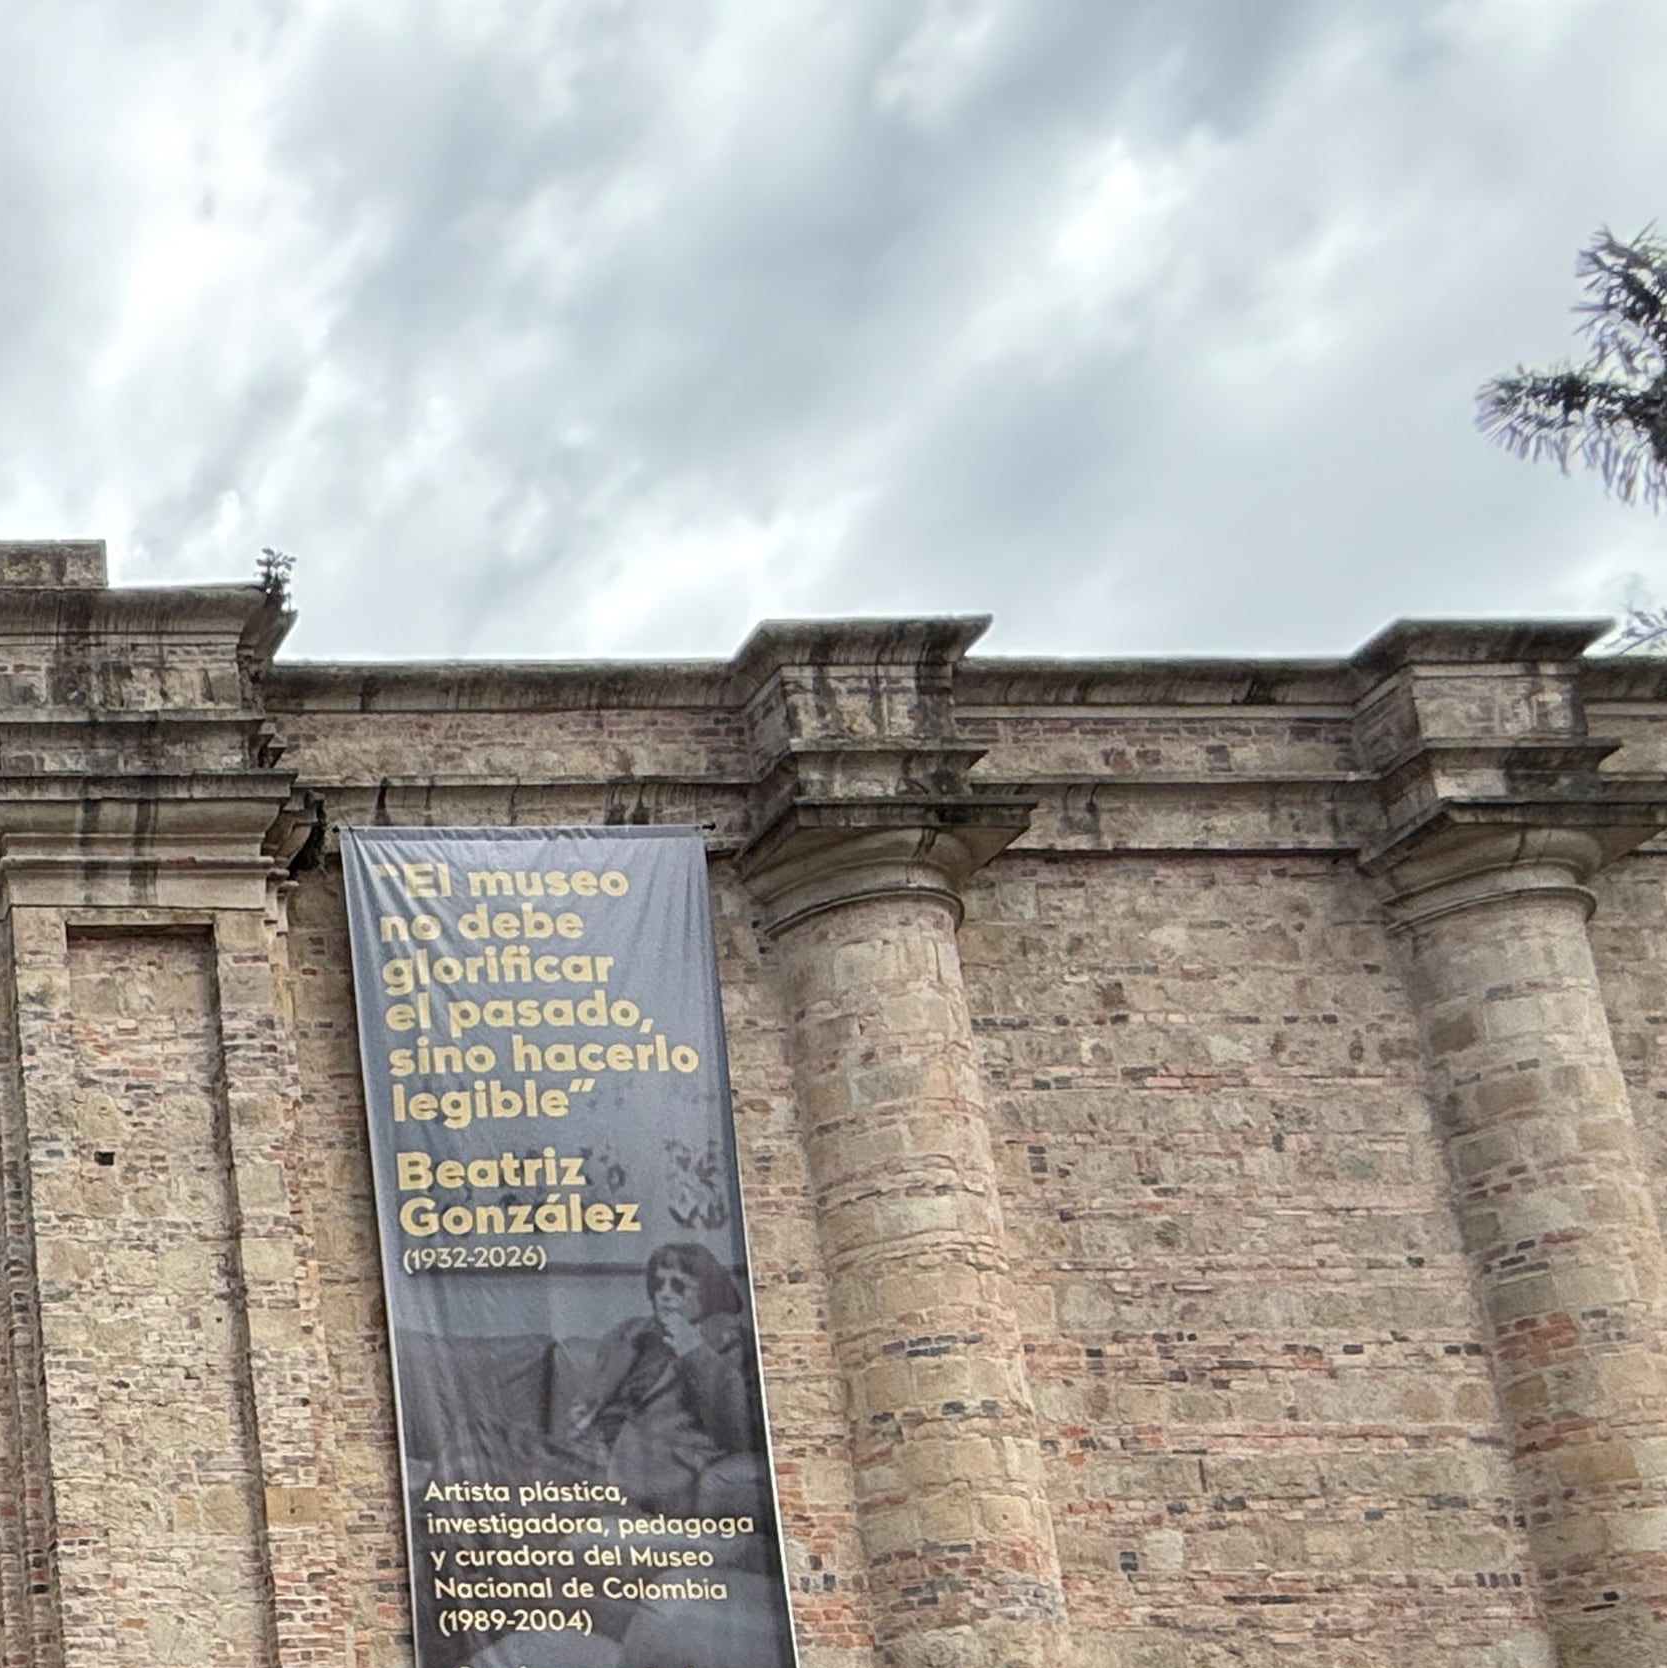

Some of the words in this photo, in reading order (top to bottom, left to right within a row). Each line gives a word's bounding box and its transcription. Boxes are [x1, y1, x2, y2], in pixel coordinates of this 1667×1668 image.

[467, 868, 630, 897] museo
[380, 913, 442, 942] no
[457, 903, 584, 940] debe
[382, 945, 614, 996] glorificar
[385, 993, 432, 1031] el
[449, 990, 653, 1038] pasado,
[389, 1038, 496, 1077] sino
[512, 1034, 699, 1073] hacerlo
[396, 1147, 587, 1192] Beatriz
[399, 1192, 642, 1237] González
[403, 1245, 547, 1275] (1932-2026)
[425, 1480, 510, 1502] Artista
[519, 1480, 628, 1507] plástica,
[427, 1513, 610, 1539] investigadora,
[619, 1514, 754, 1540] pedagoga
[430, 1550, 446, 1571] y
[455, 1544, 574, 1567] curadora
[584, 1544, 622, 1566] del
[630, 1547, 714, 1567] Museo
[434, 1577, 552, 1600] Nacional
[562, 1577, 594, 1600] de
[602, 1577, 728, 1600] Colombia
[438, 1609, 593, 1637] (1989-2004)
